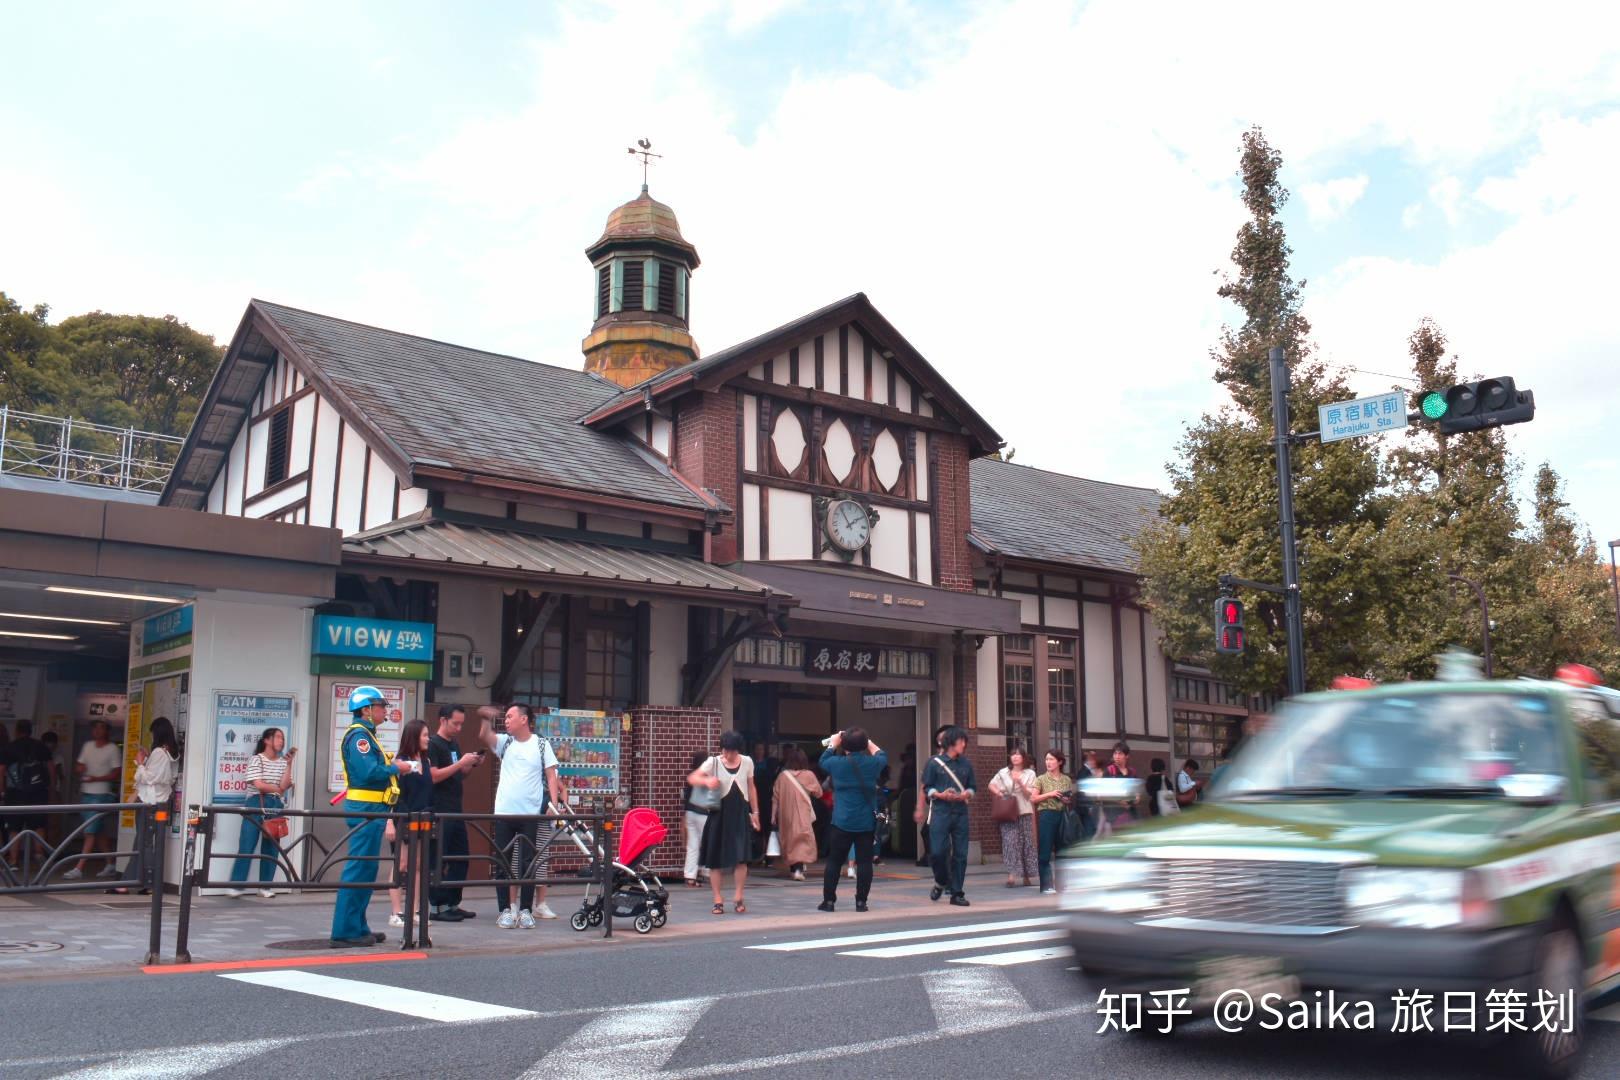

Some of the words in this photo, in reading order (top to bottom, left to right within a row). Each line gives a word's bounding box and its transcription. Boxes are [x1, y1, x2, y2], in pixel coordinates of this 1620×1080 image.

[1327, 397, 1398, 425] 原宿駅前
[1333, 422, 1370, 435] Harajuku
[396, 631, 422, 642] ATM
[396, 641, 424, 651] コーナー
[813, 647, 875, 672] 原宿駅
[231, 696, 257, 708] ATM
[218, 780, 248, 791] 18:00
